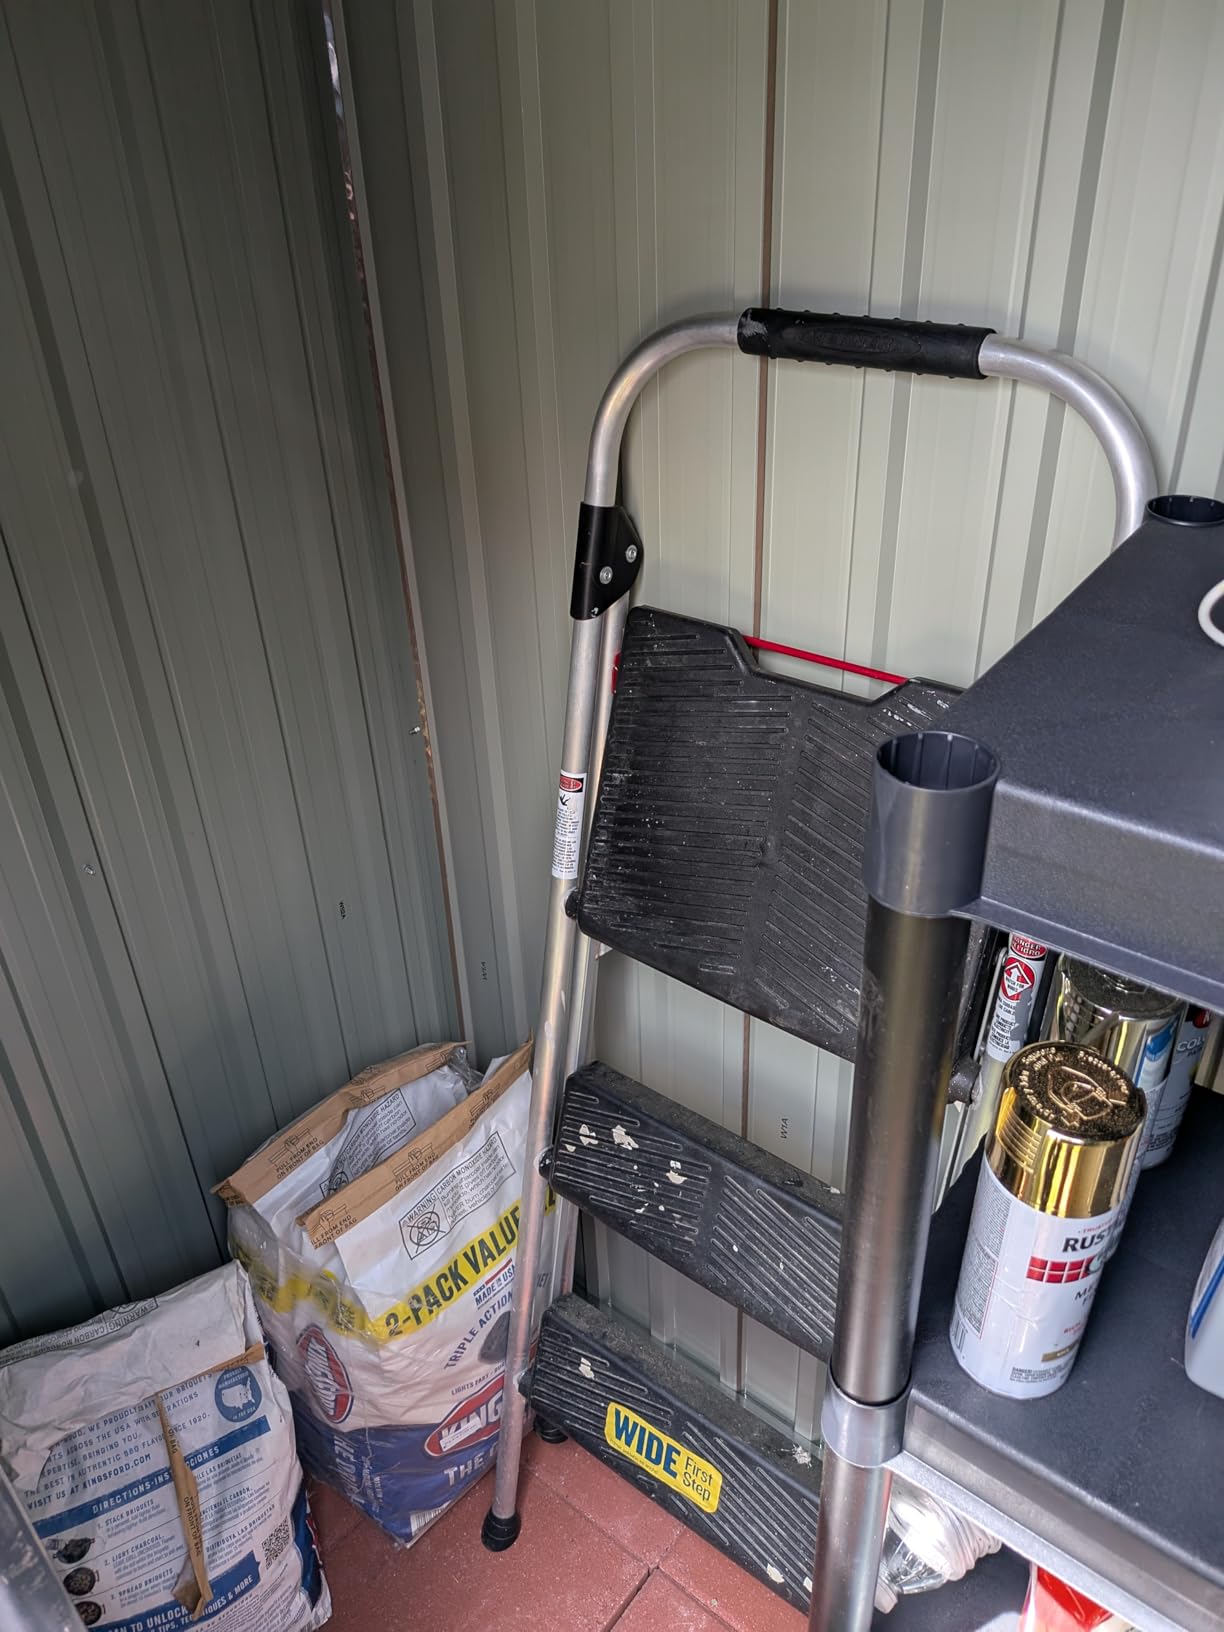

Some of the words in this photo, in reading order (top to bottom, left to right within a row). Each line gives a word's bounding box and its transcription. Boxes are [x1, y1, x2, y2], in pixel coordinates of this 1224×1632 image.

[407, 1193, 436, 1221] WARNING
[436, 1173, 457, 1195] CARBON
[385, 1259, 469, 1338] 2-PACK
[475, 1281, 497, 1307] MADE
[109, 1307, 149, 1331] WARNING
[444, 1327, 479, 1370] TRIPLE
[450, 1382, 474, 1396] LIGHTS
[88, 1423, 100, 1433] WE
[104, 1407, 138, 1427] PROUDLY
[96, 1430, 112, 1444] THE
[114, 1423, 131, 1435] USA
[122, 1432, 138, 1444] YOU
[614, 1407, 681, 1480] WIDE
[27, 1494, 53, 1511] VISIT
[55, 1490, 67, 1500] US
[70, 1484, 80, 1496] AT
[82, 1452, 152, 1490] KINGSFORD.COM
[44, 1477, 65, 1491] BEST
[78, 1454, 121, 1477] AUTHENTIC
[443, 1451, 485, 1487] THE
[684, 1455, 714, 1487] First
[682, 1471, 712, 1502] Step
[105, 1514, 125, 1527] STACK
[125, 1498, 155, 1516] BRIQUETS
[144, 1569, 174, 1587] BRIQUETS
[234, 1574, 254, 1595] MORE
[146, 1605, 189, 1629] UNLOCK
